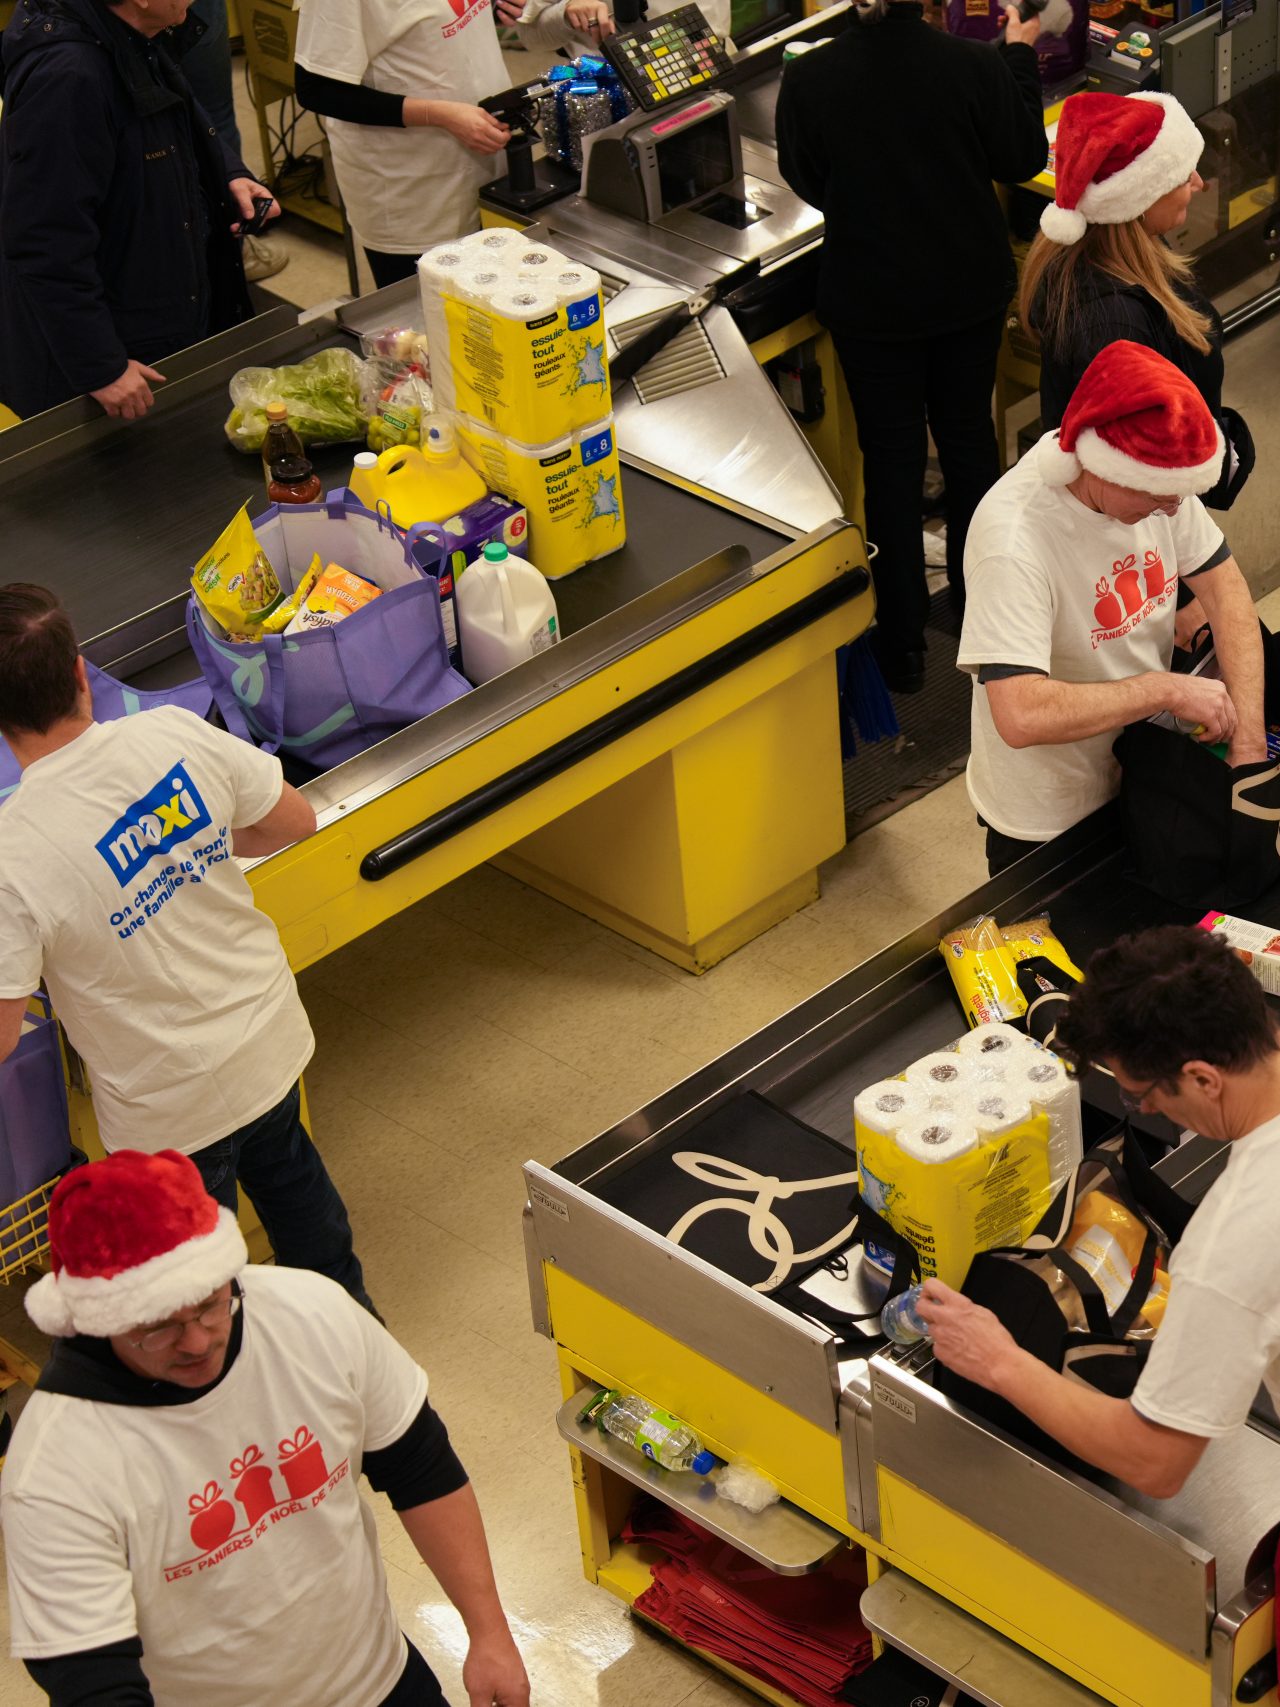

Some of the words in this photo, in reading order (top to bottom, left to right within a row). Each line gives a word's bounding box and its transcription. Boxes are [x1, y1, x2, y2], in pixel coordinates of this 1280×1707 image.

[589, 304, 595, 315] 8
[531, 328, 567, 347] essuie-
[532, 344, 554, 359] tout
[533, 352, 566, 369] rouleaux
[600, 439, 607, 450] 8
[545, 464, 581, 484] essuie-
[546, 480, 568, 495] tout
[548, 487, 580, 505] rouleaux
[326, 585, 360, 607] CHEDDAR
[1096, 623, 1131, 642] PANIERS
[108, 778, 200, 872] maxi
[110, 906, 132, 926] On
[134, 865, 175, 908] change
[180, 860, 194, 874] le
[118, 915, 146, 939] une
[144, 877, 184, 917] famille
[190, 874, 201, 883] à
[207, 850, 230, 866] foi
[972, 994, 990, 1024] aghetti
[905, 1226, 935, 1245] géants
[869, 1241, 877, 1254] 8
[920, 1254, 937, 1268] tou
[164, 1566, 192, 1583] LES
[198, 1535, 253, 1572] PANIERS
[255, 1520, 267, 1538] DE
[270, 1501, 307, 1524] NOËL
[312, 1489, 326, 1508] DE
